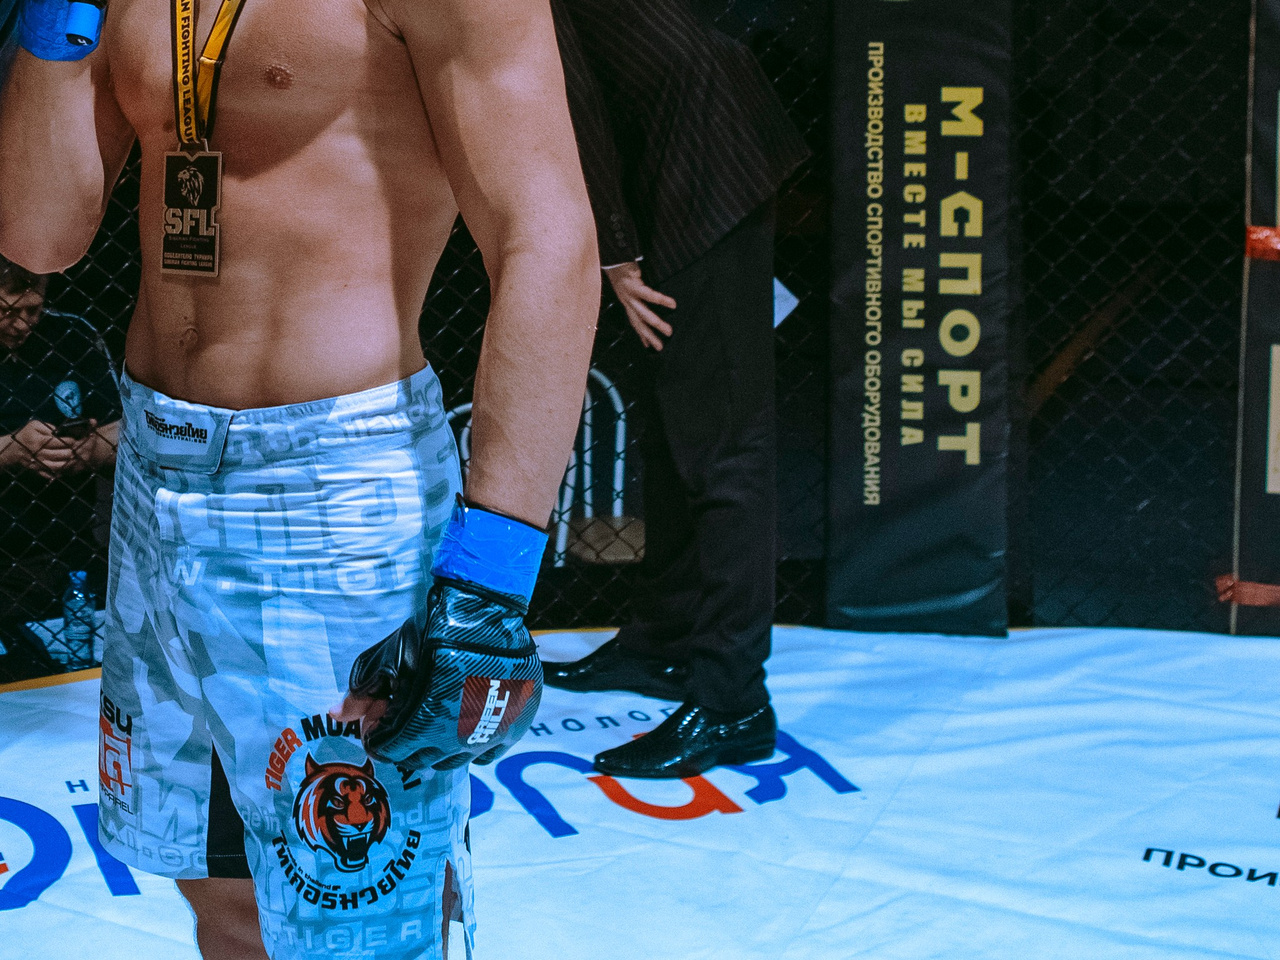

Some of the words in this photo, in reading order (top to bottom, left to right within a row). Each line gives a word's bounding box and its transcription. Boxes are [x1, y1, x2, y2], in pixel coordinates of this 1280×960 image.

[181, 15, 191, 86] FIGHTING
[865, 42, 884, 199] ПРОИЗВОДСТВО
[903, 104, 927, 249] ВМЕСТЕ
[164, 208, 215, 236] SFL
[865, 203, 883, 346] СПОРТИВНОГО
[902, 268, 925, 328] МЫ
[938, 87, 984, 466] М-СПОРТ
[862, 350, 881, 505] ОБОРУДОВАНИЯ
[901, 348, 924, 447] СИЛА
[265, 727, 303, 791] TIGER
[300, 713, 362, 742] MUA
[467, 679, 501, 745] GREEN
[1142, 847, 1280, 888] ПРОИ
